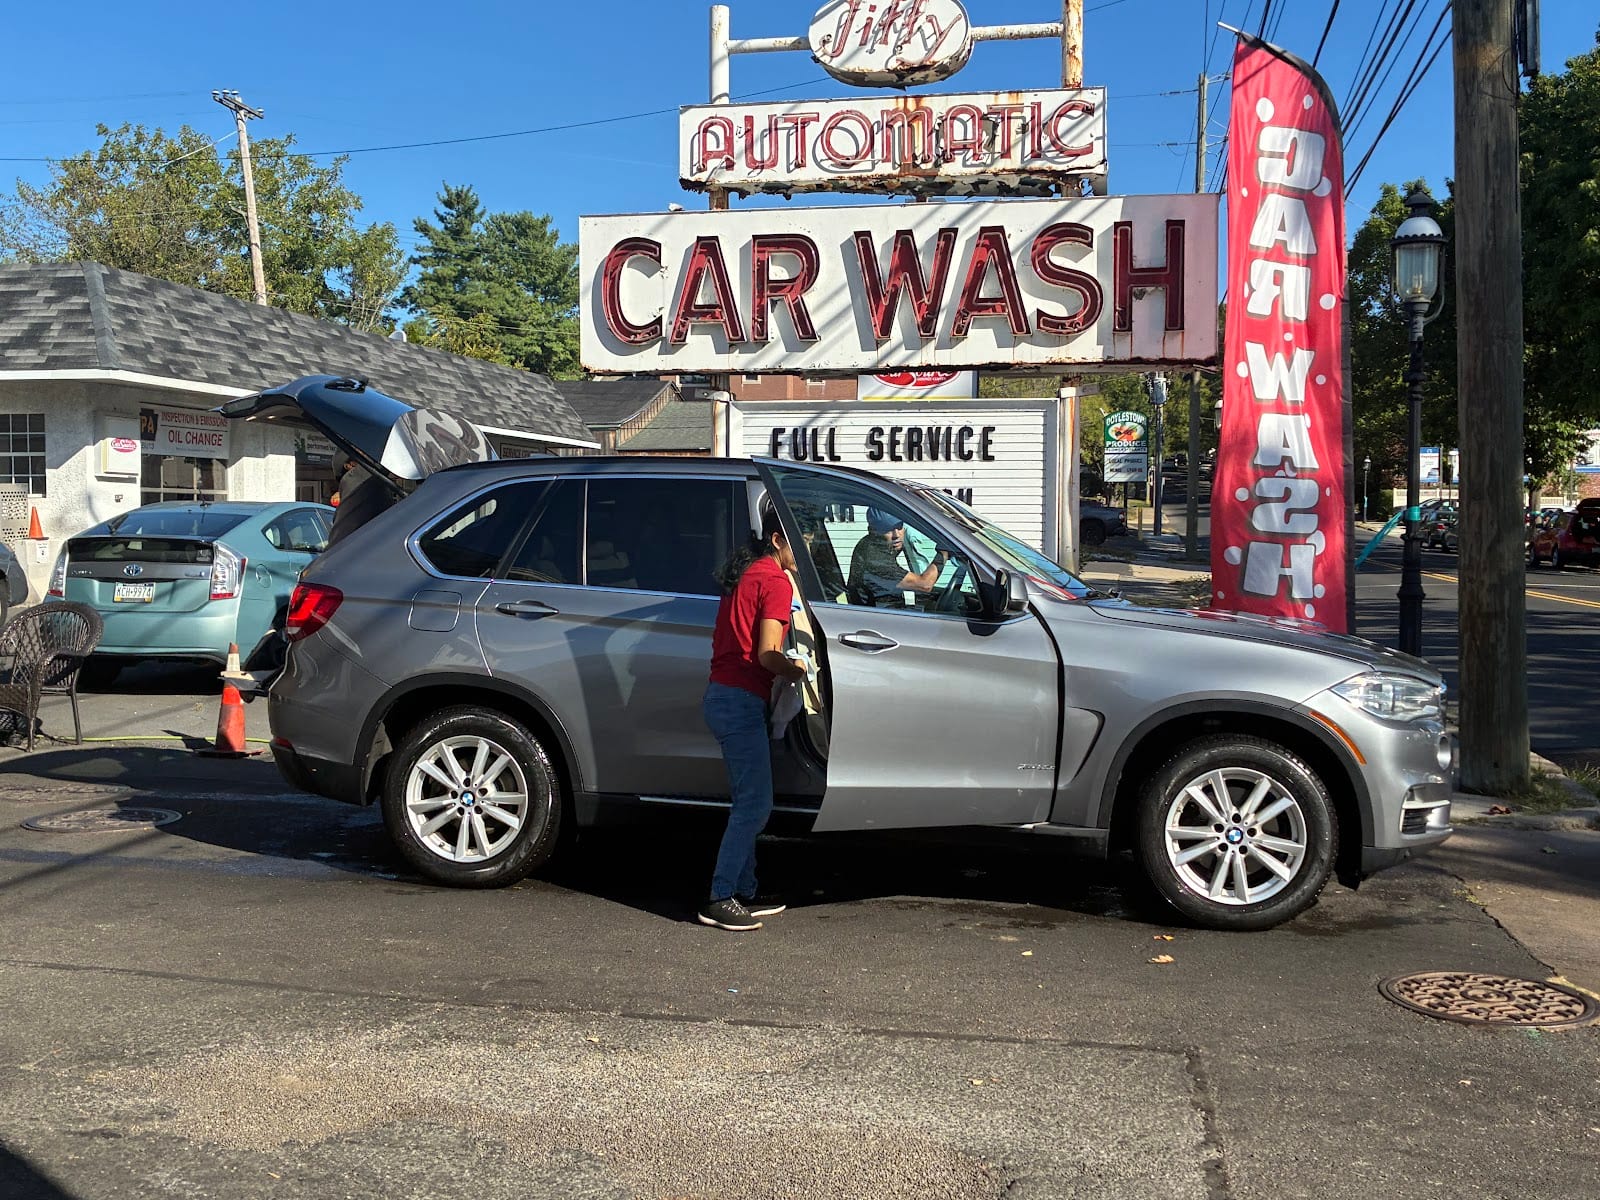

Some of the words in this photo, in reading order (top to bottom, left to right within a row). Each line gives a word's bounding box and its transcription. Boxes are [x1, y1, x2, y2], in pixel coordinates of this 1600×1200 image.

[697, 100, 1095, 172] AUTOMATIC
[602, 233, 821, 345] CAR
[853, 219, 1186, 339] WASH
[161, 411, 195, 425] INSPECTION
[200, 415, 229, 427] EMISSIONS
[168, 430, 183, 444] OIL
[185, 431, 223, 447] CHANGE
[770, 427, 842, 462] FULL
[867, 426, 996, 462] SERVICE
[1105, 440, 1147, 448] PRODUCE
